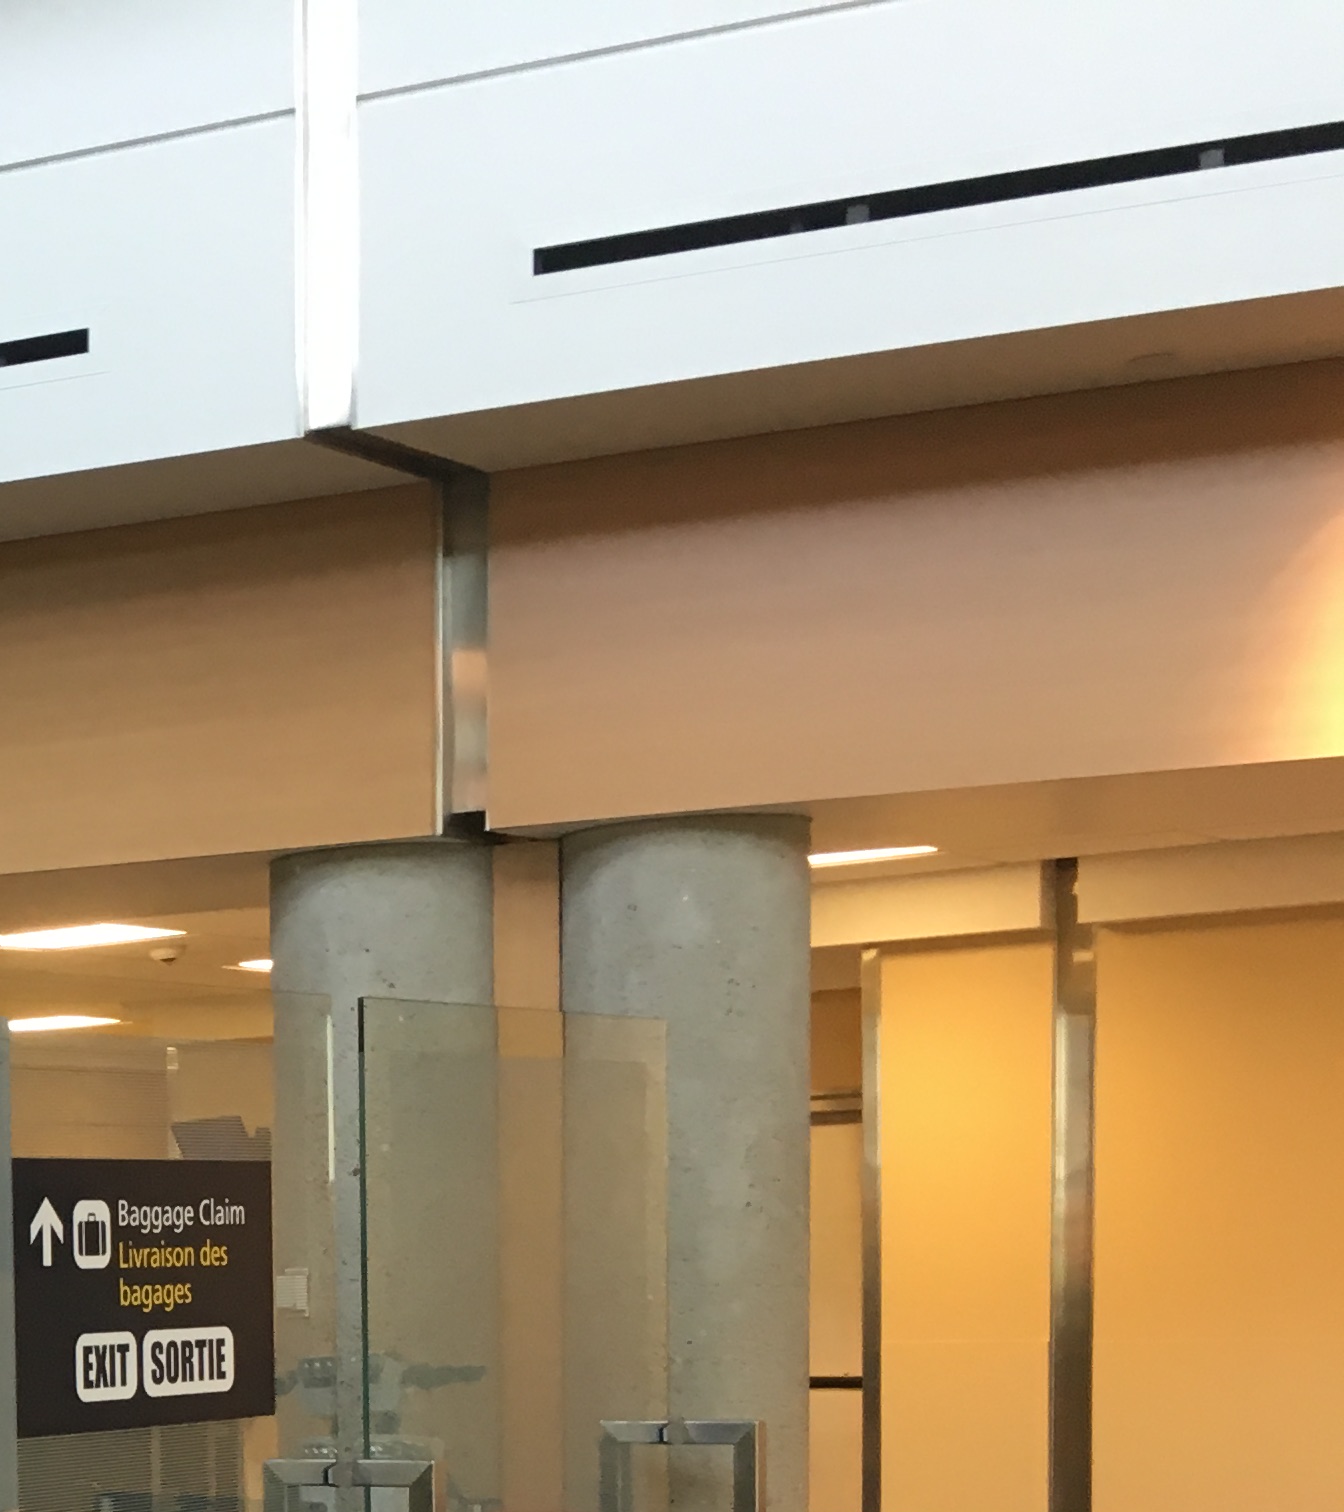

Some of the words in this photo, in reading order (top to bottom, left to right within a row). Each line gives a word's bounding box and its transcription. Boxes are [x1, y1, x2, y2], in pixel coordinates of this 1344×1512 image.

[117, 1199, 195, 1234] Baggage
[198, 1198, 246, 1226] Claim
[118, 1239, 195, 1269] Livraison
[199, 1238, 228, 1267] des
[119, 1277, 193, 1313] bagages
[82, 1342, 130, 1390] EXIT
[150, 1337, 227, 1386] SORTIE
